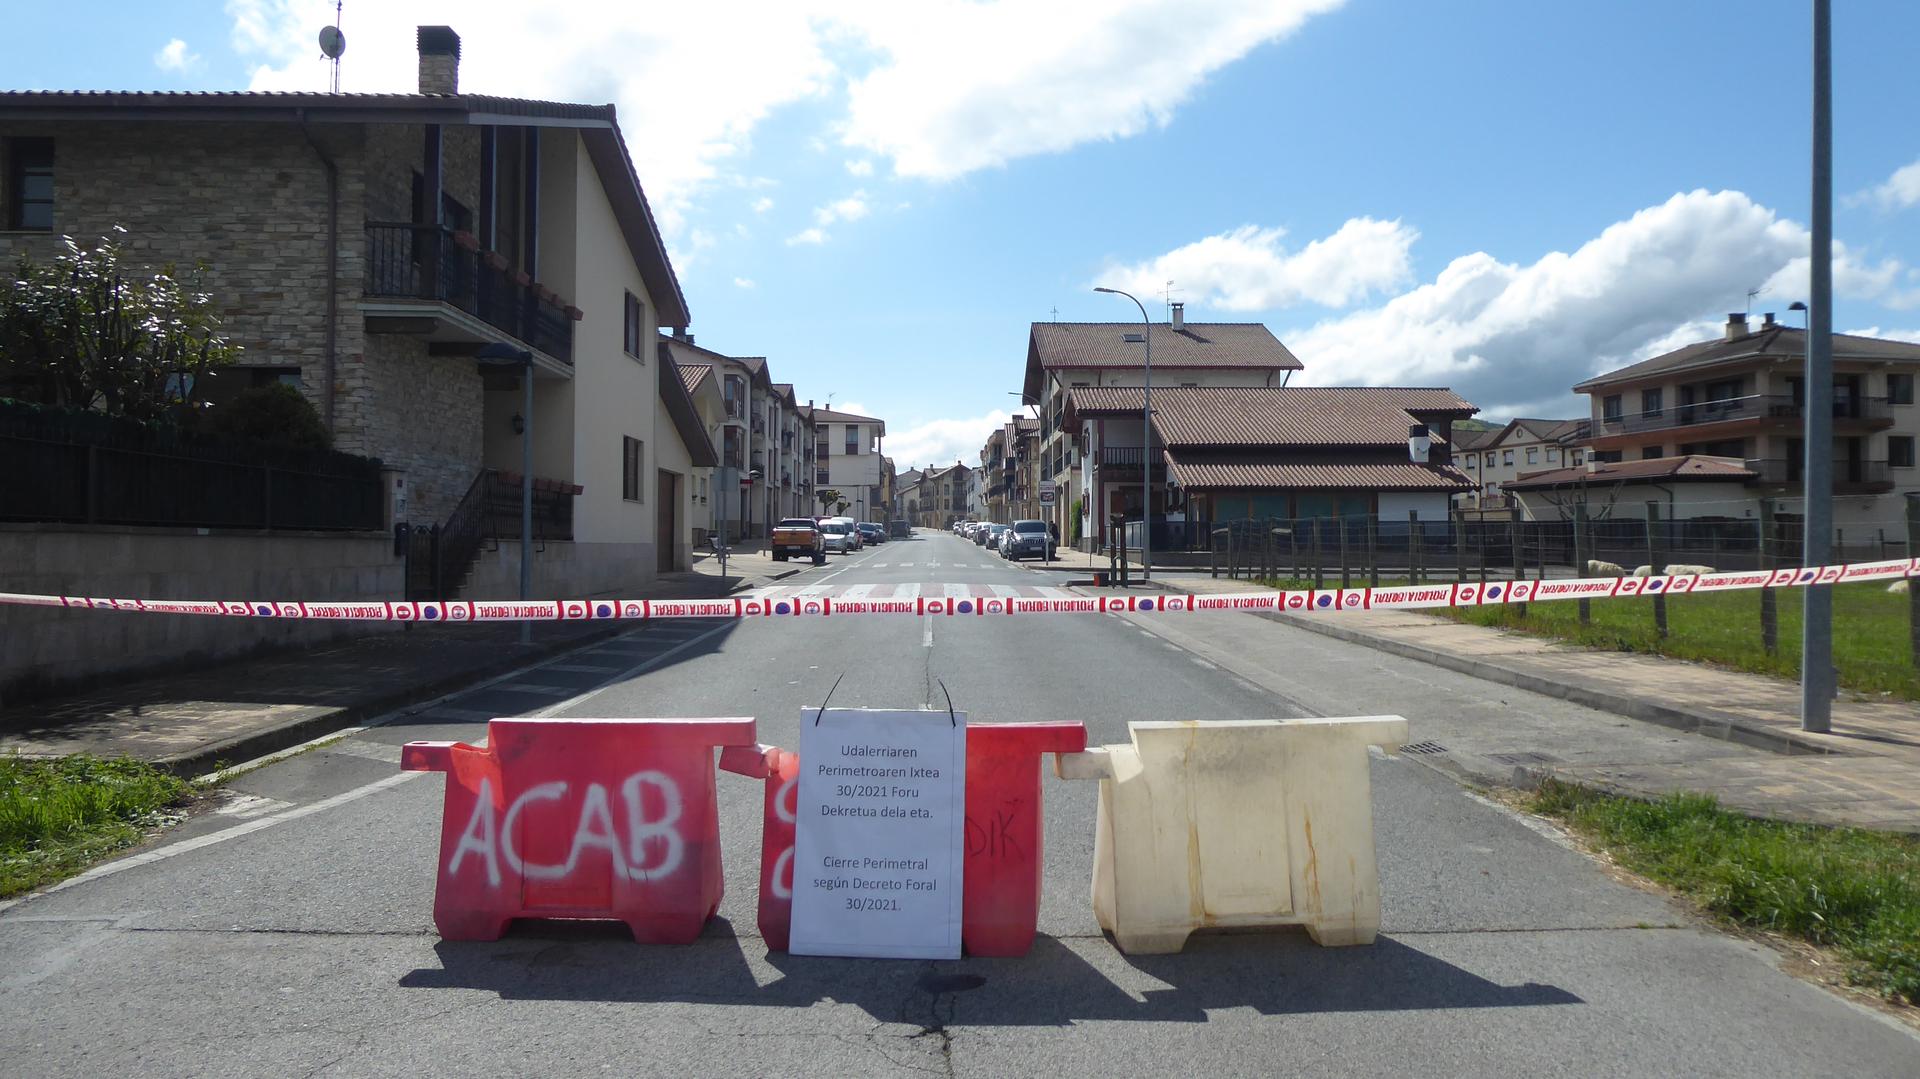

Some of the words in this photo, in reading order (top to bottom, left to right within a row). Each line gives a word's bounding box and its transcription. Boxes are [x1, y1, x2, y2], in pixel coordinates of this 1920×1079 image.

[841, 745, 917, 758] Udalerriaren
[818, 764, 906, 778] Perimetroaren
[910, 766, 940, 779] Ixtea
[836, 784, 887, 798] 30/2021
[892, 786, 919, 798] Foru
[821, 804, 876, 818] Dekretua
[880, 805, 906, 818] dela
[910, 807, 933, 818] eta.
[448, 769, 685, 888] ACAB
[823, 856, 860, 869] Cierre
[863, 857, 928, 870] Perimetral
[813, 876, 849, 891] según
[853, 878, 902, 890] Decreto
[906, 878, 937, 891] Foral
[845, 898, 902, 912] 30/2021.
